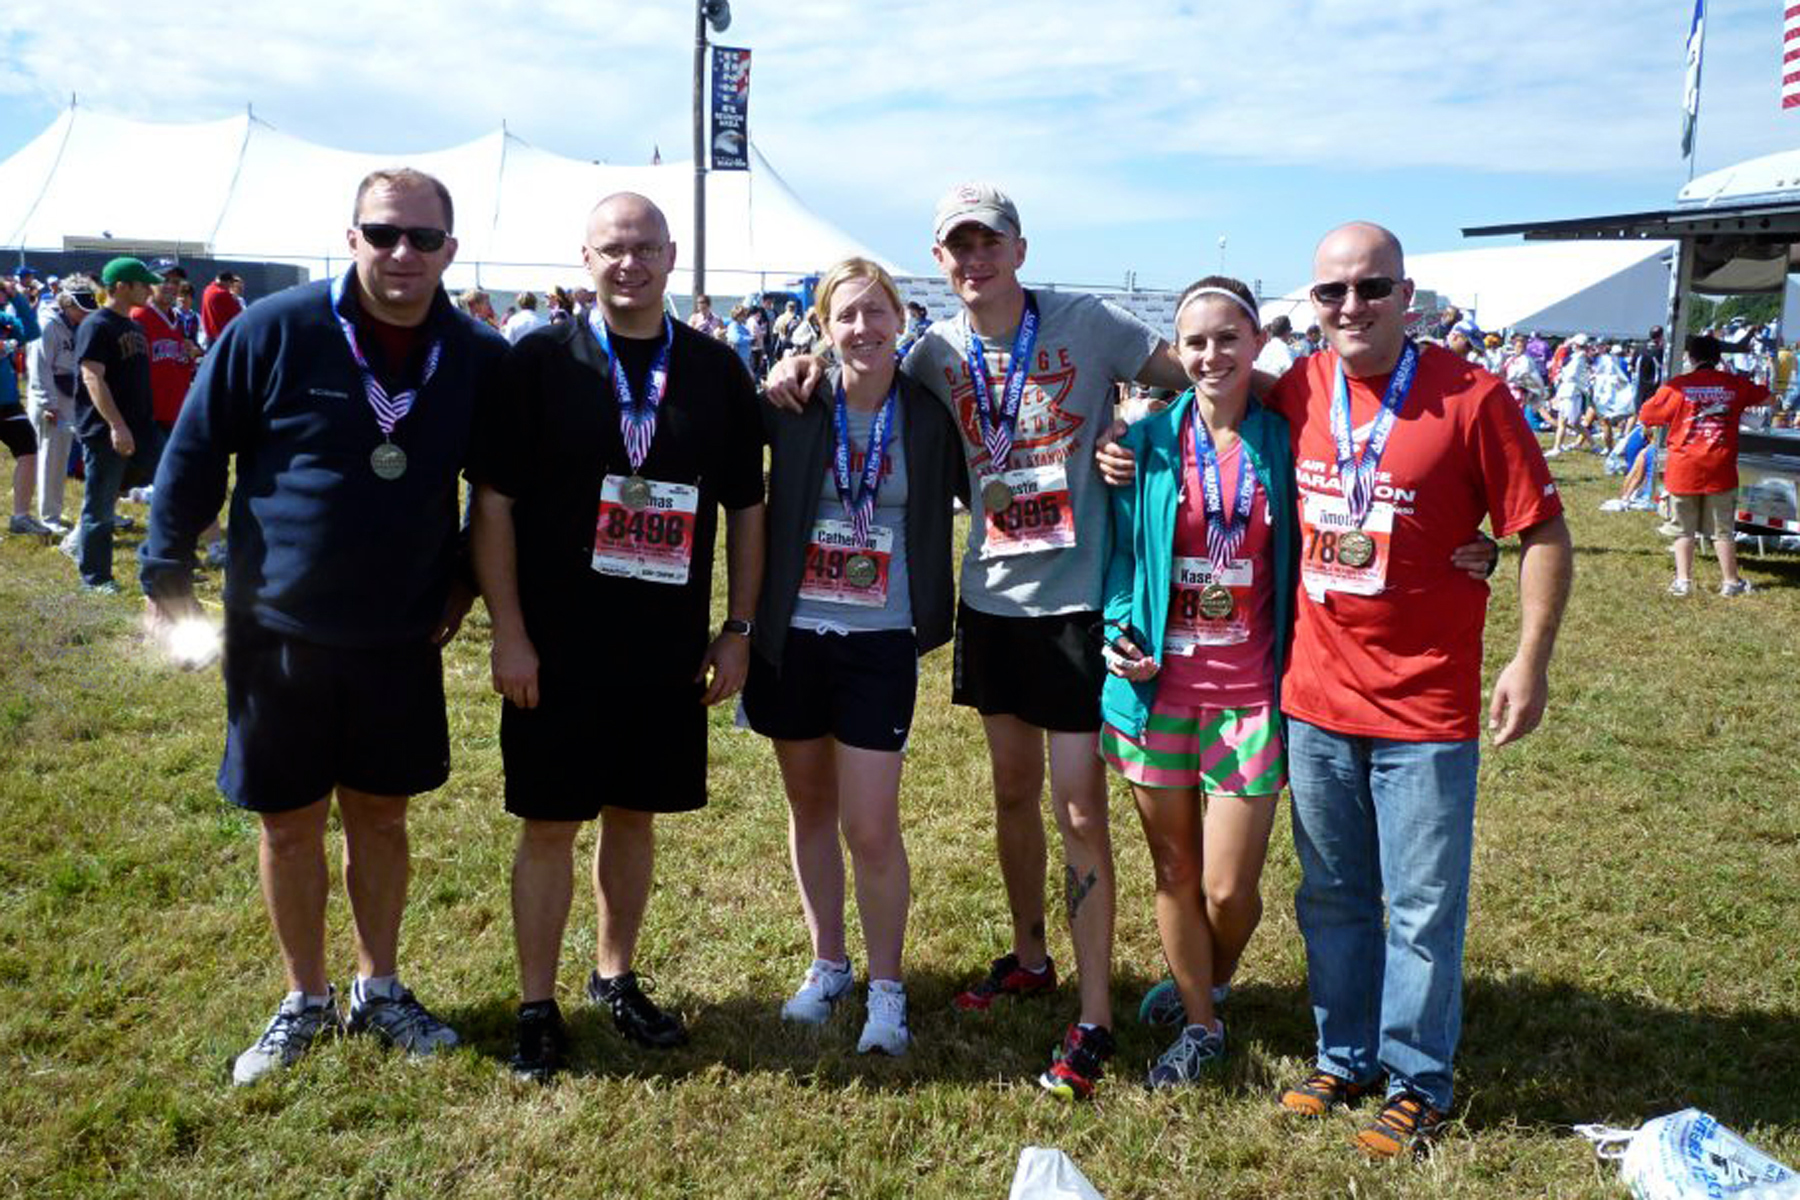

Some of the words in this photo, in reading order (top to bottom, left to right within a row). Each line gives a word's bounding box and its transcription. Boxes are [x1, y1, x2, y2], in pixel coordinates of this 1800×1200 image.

[944, 347, 1072, 386] COLGE
[1296, 467, 1416, 502] ARAON
[1180, 569, 1212, 584] Kase
